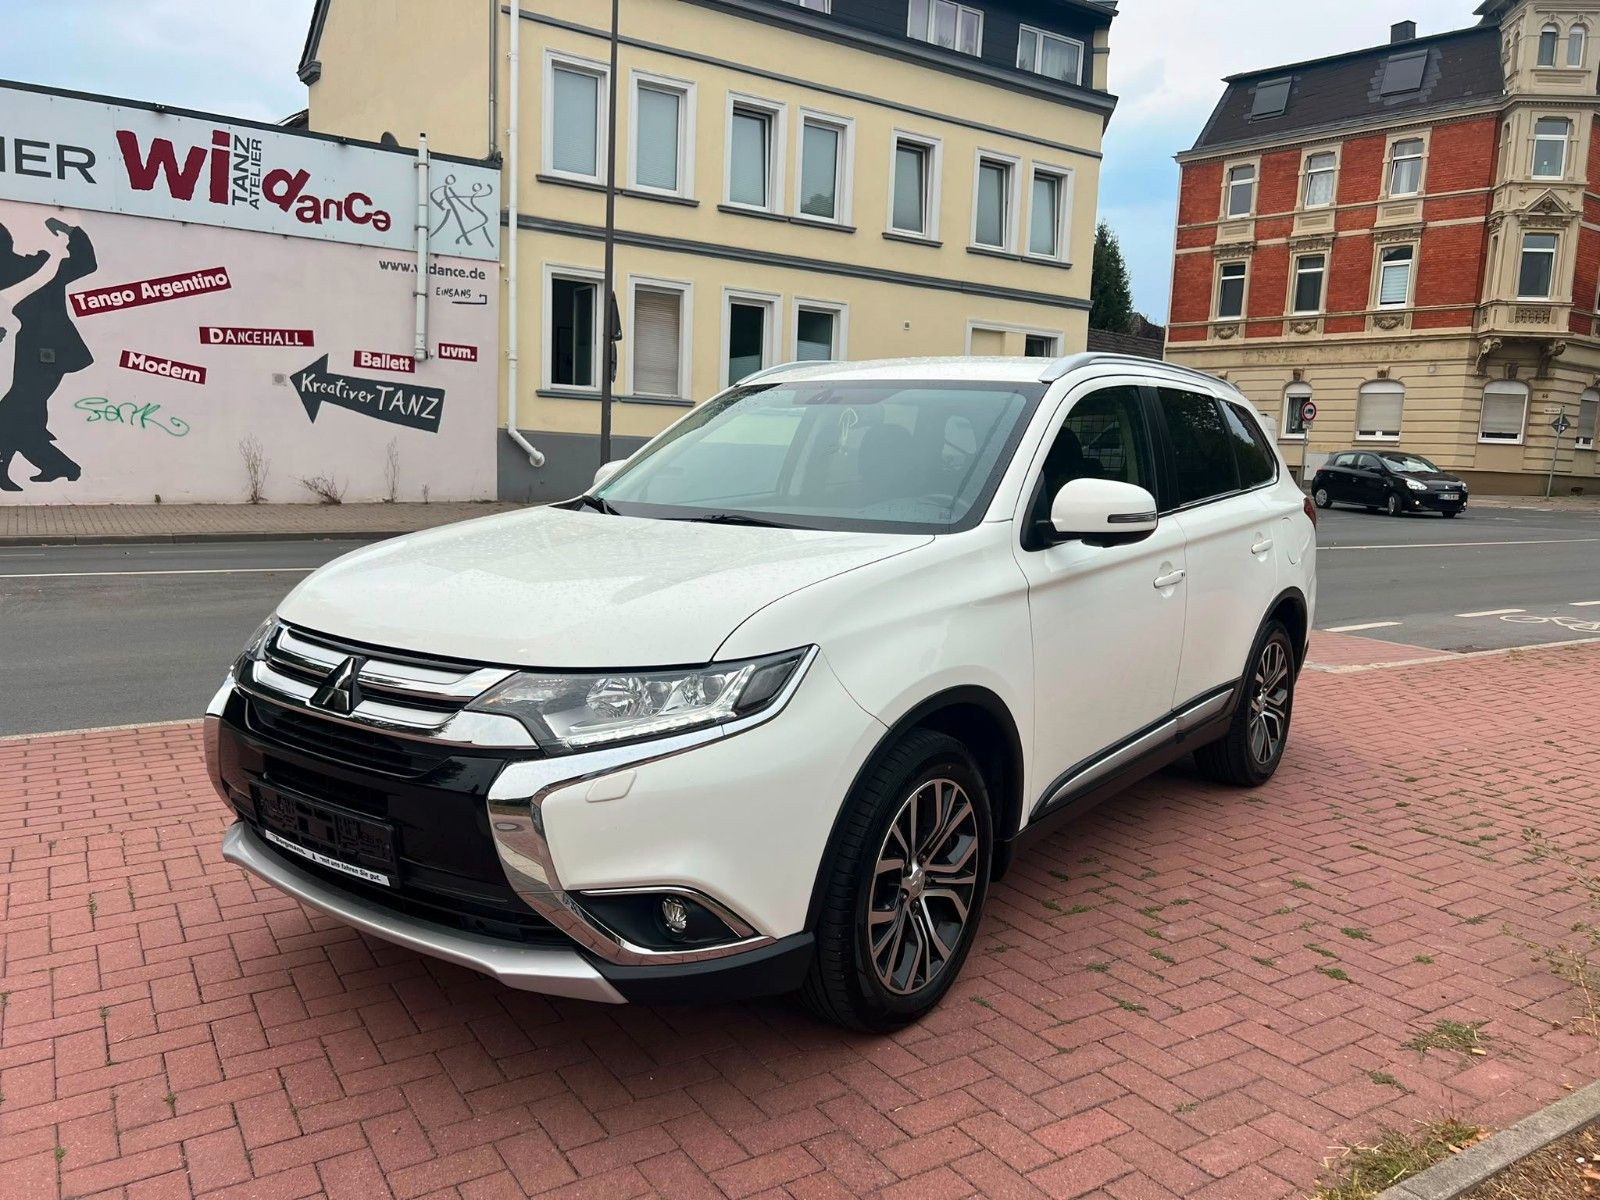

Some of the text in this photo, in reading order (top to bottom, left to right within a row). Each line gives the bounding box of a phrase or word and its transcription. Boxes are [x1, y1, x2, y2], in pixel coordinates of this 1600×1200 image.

[231, 134, 251, 206] TANZ
[249, 138, 262, 211] ATELIER
[74, 272, 228, 311] Tango Argentino
[208, 327, 304, 346] DANCEHALL
[440, 345, 476, 360] uvm.
[127, 351, 202, 383] Modern
[360, 351, 411, 372] Ballett
[301, 372, 440, 420] Kreativer TANZ
